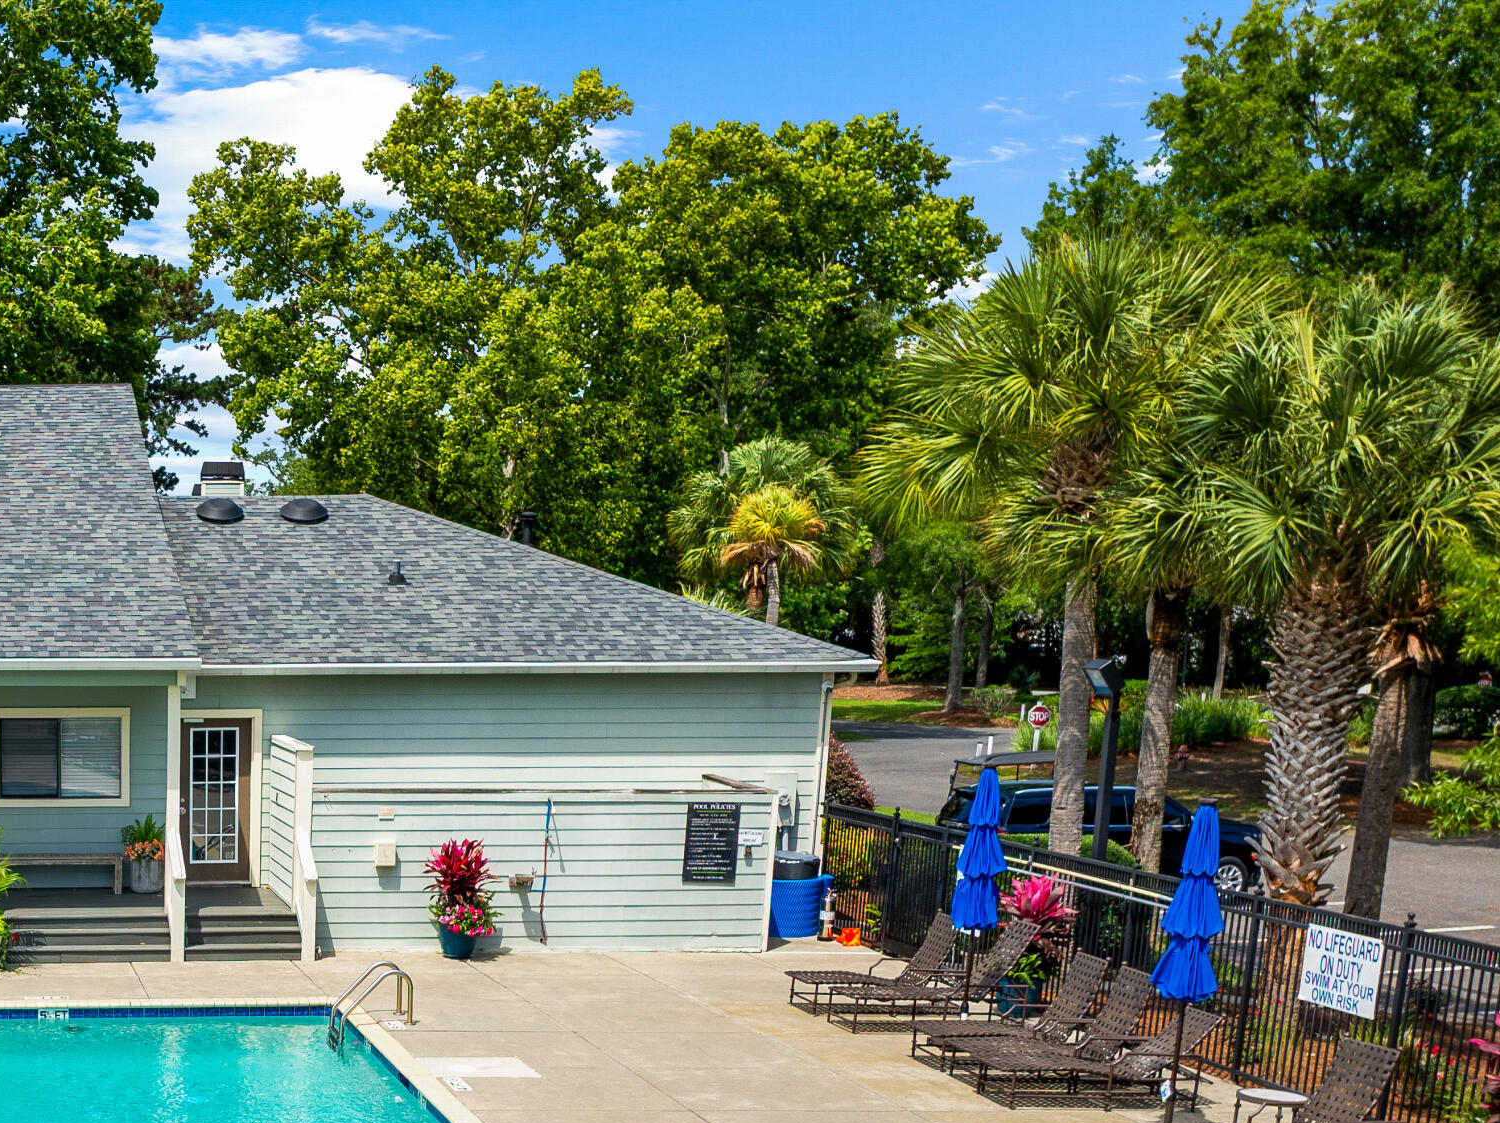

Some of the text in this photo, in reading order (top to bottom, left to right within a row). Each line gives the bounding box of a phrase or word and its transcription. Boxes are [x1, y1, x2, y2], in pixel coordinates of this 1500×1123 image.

[1030, 711, 1050, 721] STOP
[1308, 928, 1380, 962] NO LIFEGUARD
[1320, 954, 1363, 982] ON DUTY
[1305, 970, 1374, 1002] SWIM AT YOUR
[1311, 988, 1359, 1013] OWN RISK
[54, 1010, 68, 1019] FT
